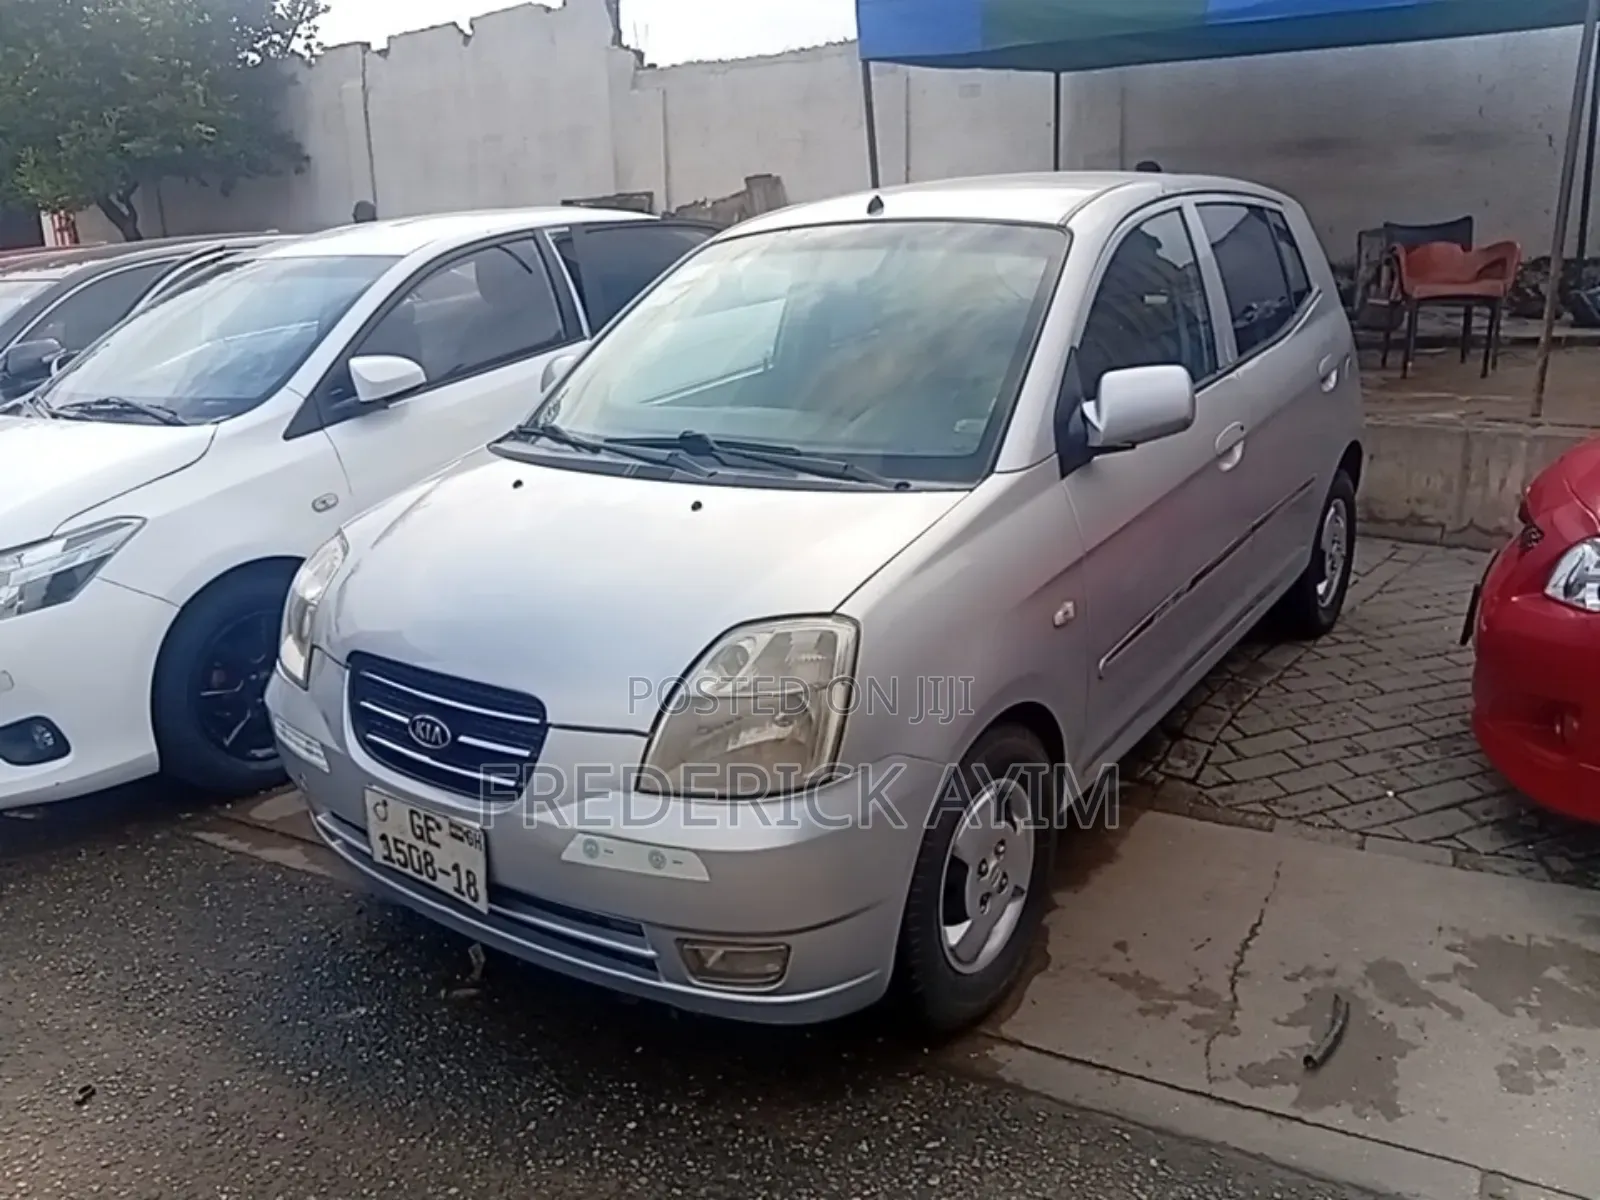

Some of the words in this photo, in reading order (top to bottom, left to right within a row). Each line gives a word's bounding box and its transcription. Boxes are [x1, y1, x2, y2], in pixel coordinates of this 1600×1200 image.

[413, 720, 443, 746] KIA
[409, 808, 442, 849] GE
[378, 833, 480, 903] 1508-18
